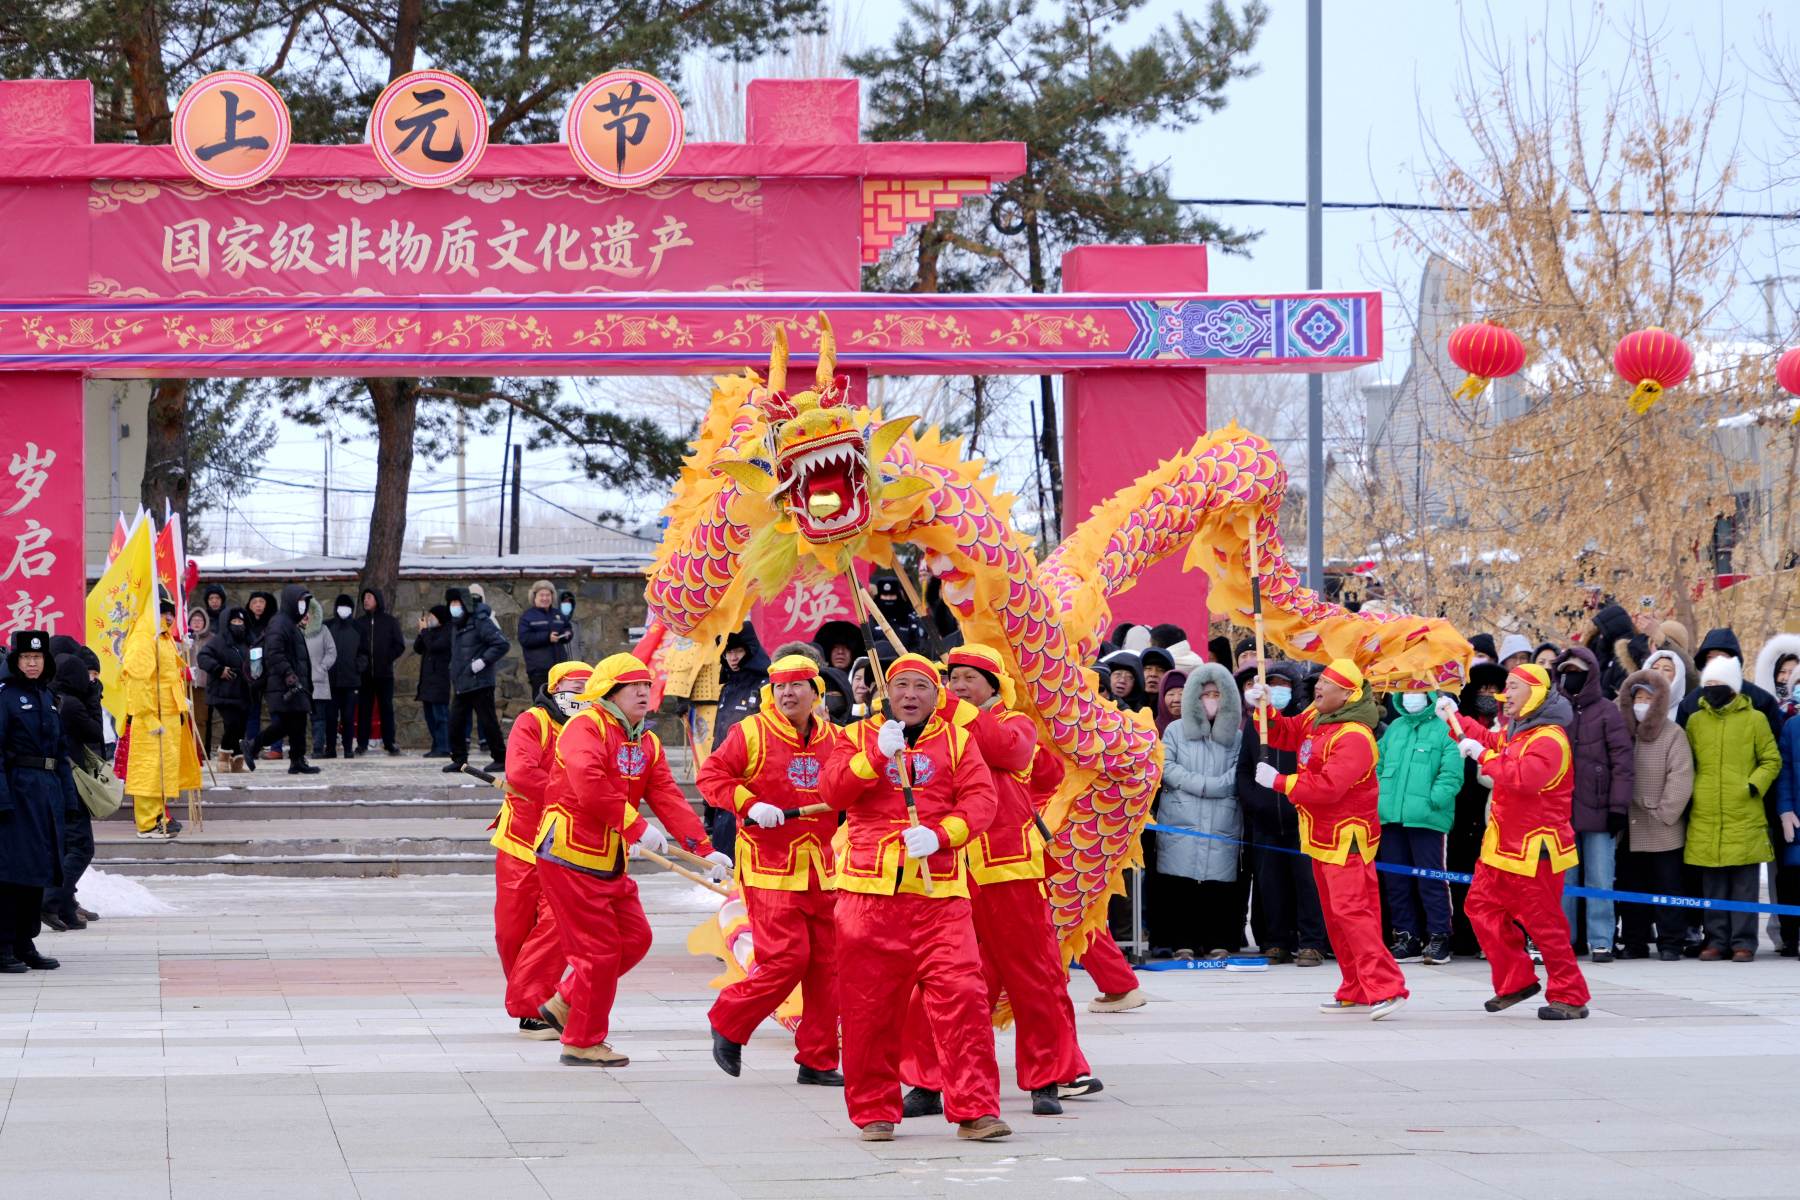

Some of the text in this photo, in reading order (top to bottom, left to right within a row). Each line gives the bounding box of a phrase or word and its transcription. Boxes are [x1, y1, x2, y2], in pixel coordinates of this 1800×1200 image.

[195, 82, 657, 181] 上元节
[161, 215, 694, 279] 国家级非物质文化遗产
[0, 441, 64, 646] 岁启新
[1430, 870, 1460, 881] POLICE
[1671, 897, 1701, 907] POLICE
[1197, 960, 1227, 969] POLICE
